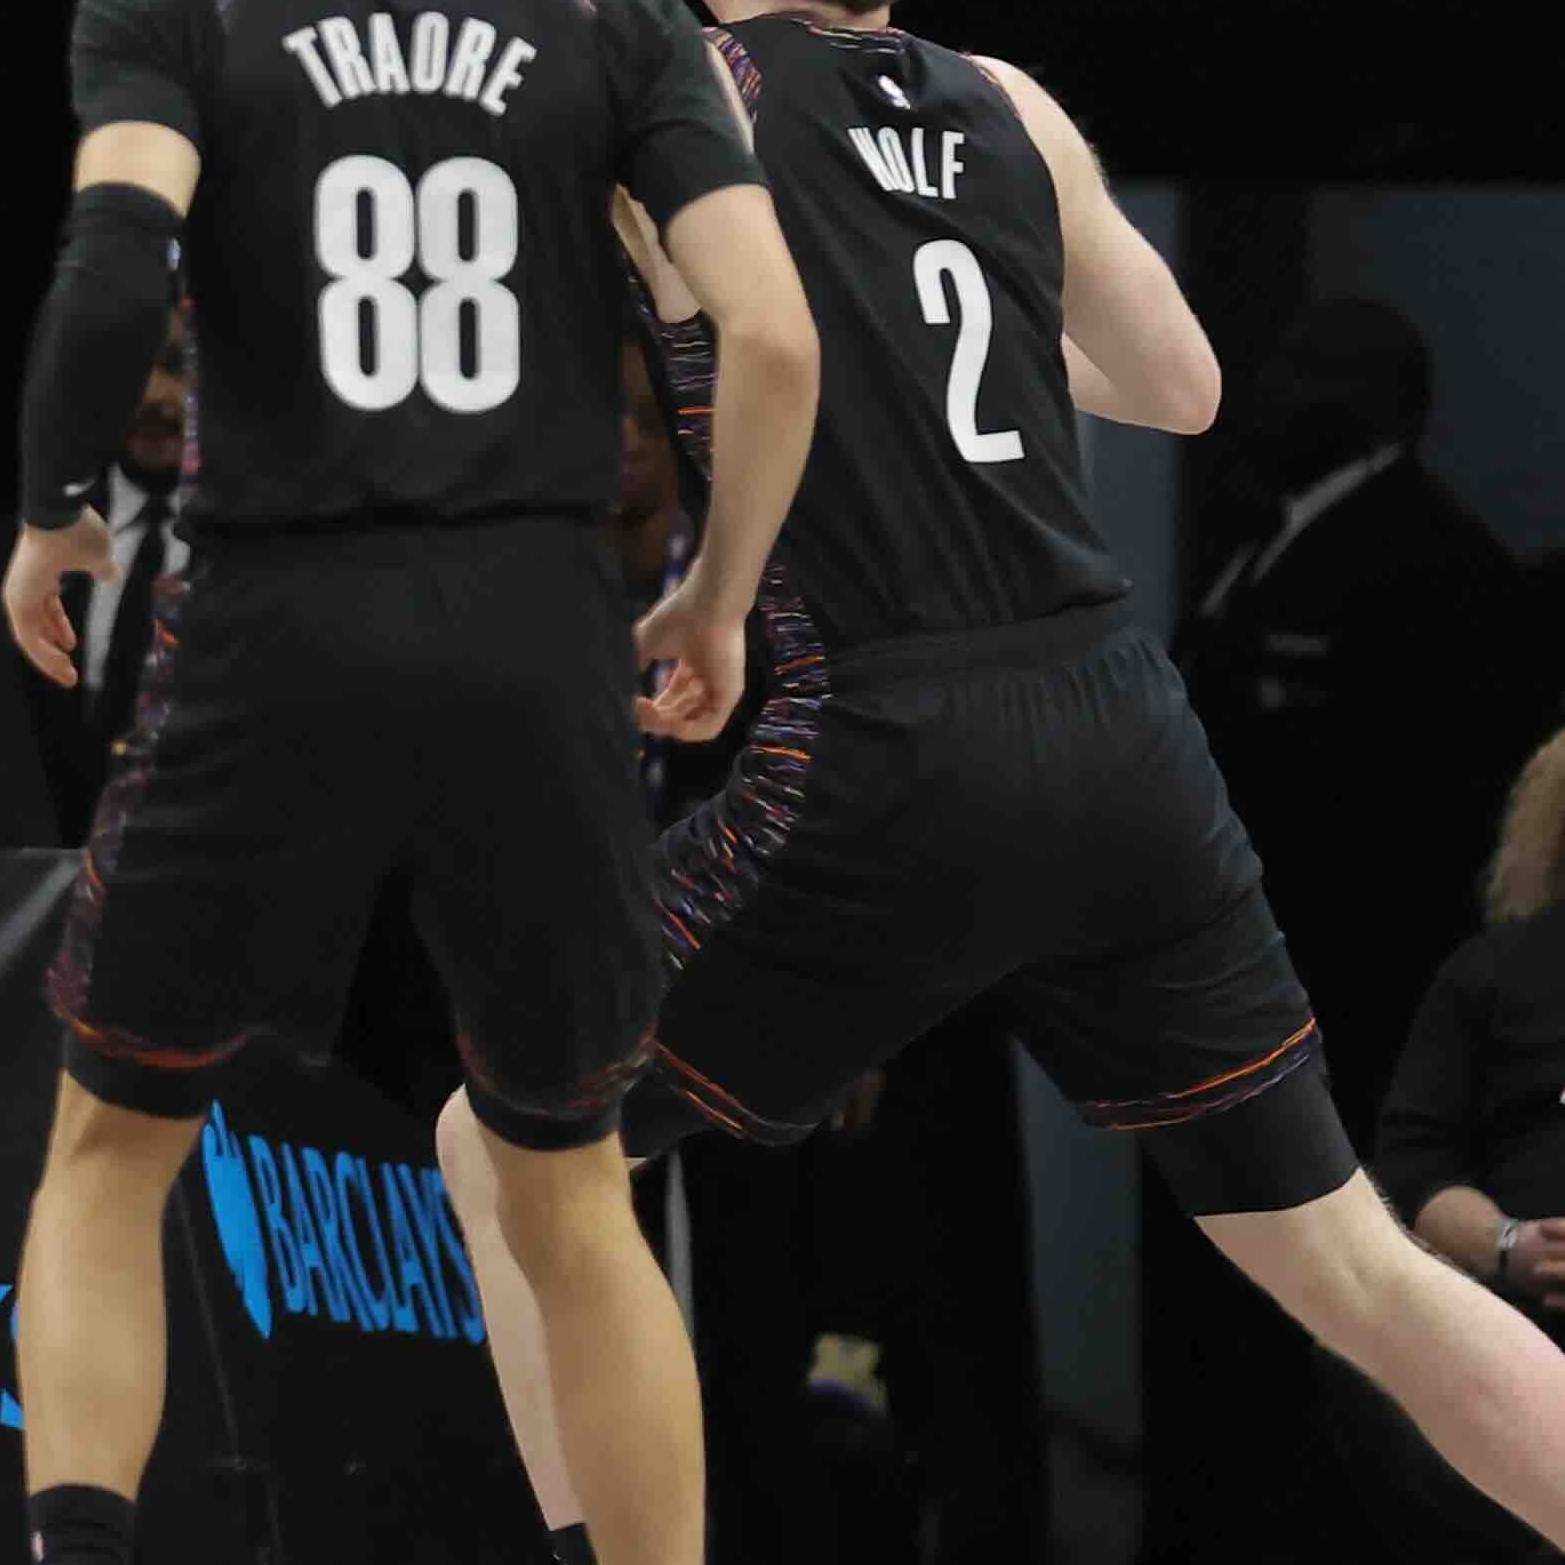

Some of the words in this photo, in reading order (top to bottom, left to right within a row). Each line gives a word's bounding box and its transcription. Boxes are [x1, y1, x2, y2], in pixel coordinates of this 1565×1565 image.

[282, 11, 538, 116] TRAORE
[847, 126, 966, 200] WOLF
[313, 154, 521, 414] 88
[912, 238, 1026, 464] 2
